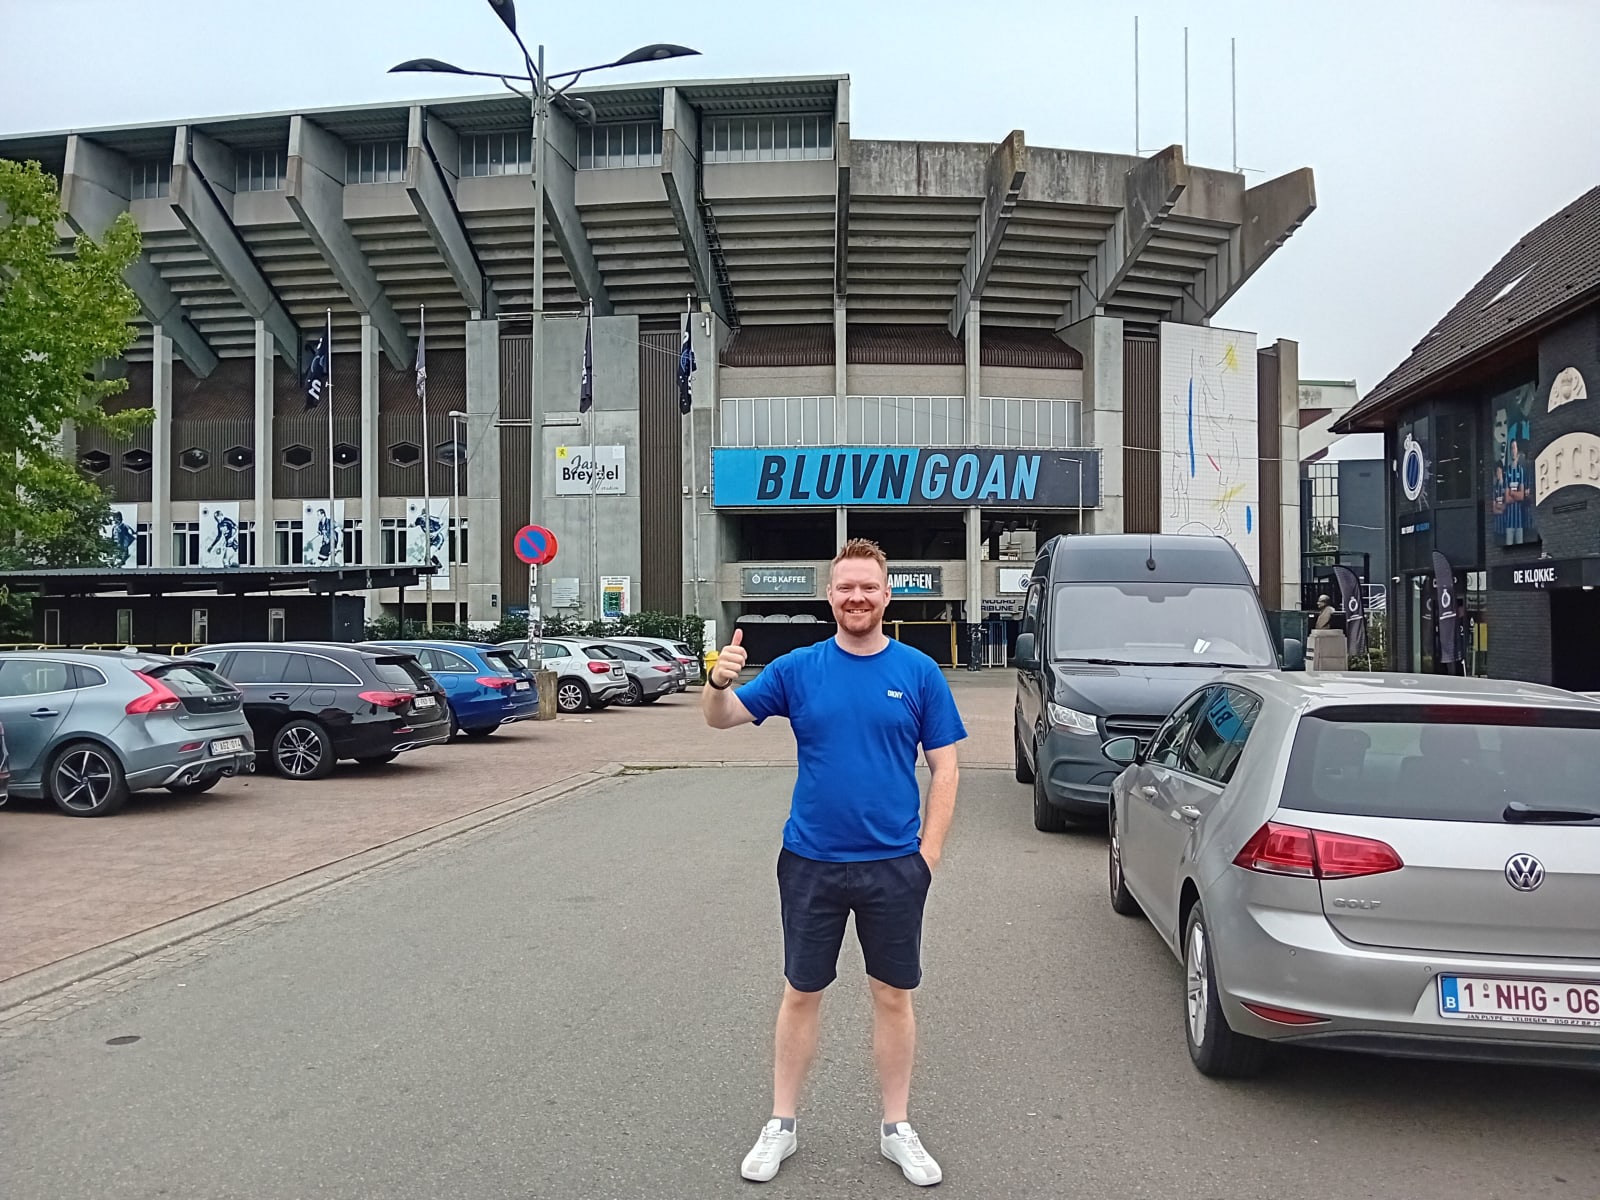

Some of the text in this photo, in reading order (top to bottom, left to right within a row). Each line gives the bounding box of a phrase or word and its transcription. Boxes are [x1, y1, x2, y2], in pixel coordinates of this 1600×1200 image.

[571, 455, 598, 474] Jan
[562, 465, 619, 484] Breydel
[757, 453, 1041, 500] BLUVN GOAN
[1513, 567, 1555, 584] DE KLOKKE
[887, 689, 903, 699] DKNY
[1333, 897, 1381, 910] GOLF
[1446, 996, 1456, 1008] B
